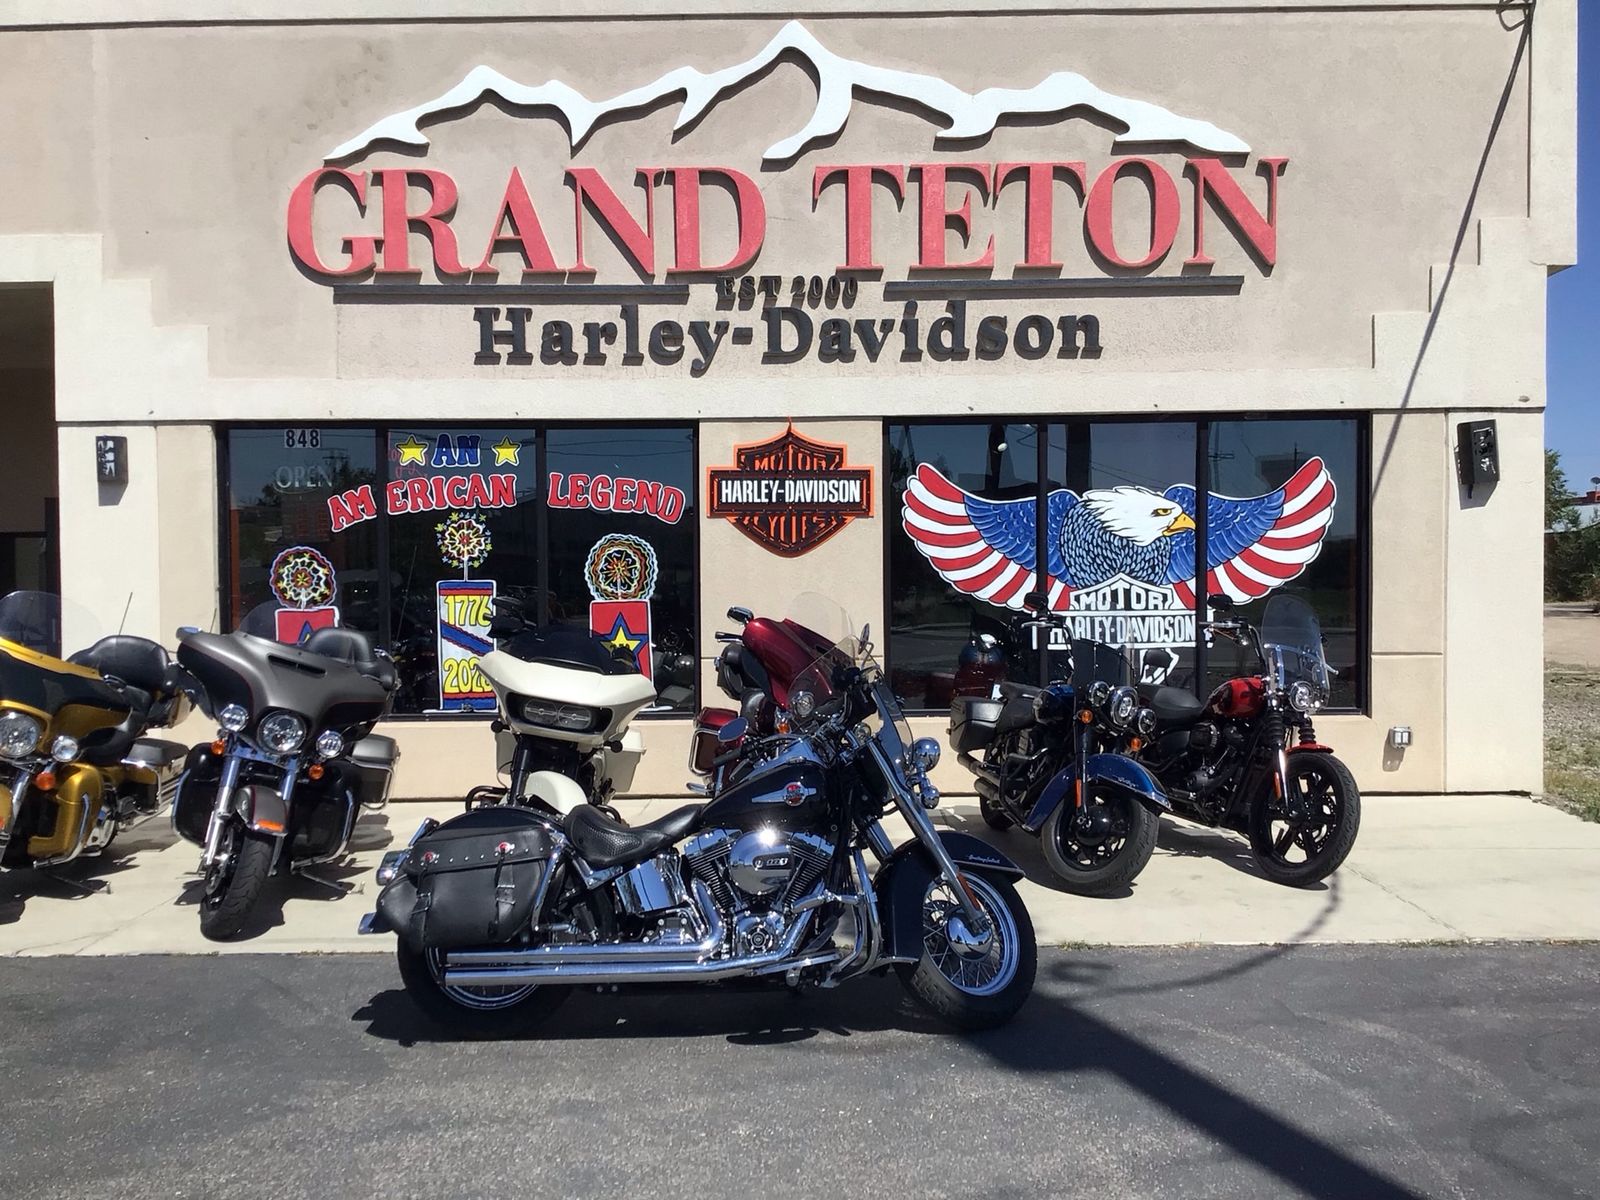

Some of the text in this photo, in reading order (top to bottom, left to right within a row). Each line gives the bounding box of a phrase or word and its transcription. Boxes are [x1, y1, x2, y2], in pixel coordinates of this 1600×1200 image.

[286, 156, 1290, 277] GRAND TETON
[715, 274, 858, 306] EST 2000
[473, 299, 1104, 377] Harley-Davidson
[285, 429, 320, 448] 848
[431, 433, 481, 468] AN
[274, 465, 334, 488] OPEN
[720, 479, 862, 504] HARLEY-DAVIDSON
[547, 472, 686, 524] LEGEND
[444, 595, 493, 627] 1776
[1079, 580, 1165, 611] MOTOR
